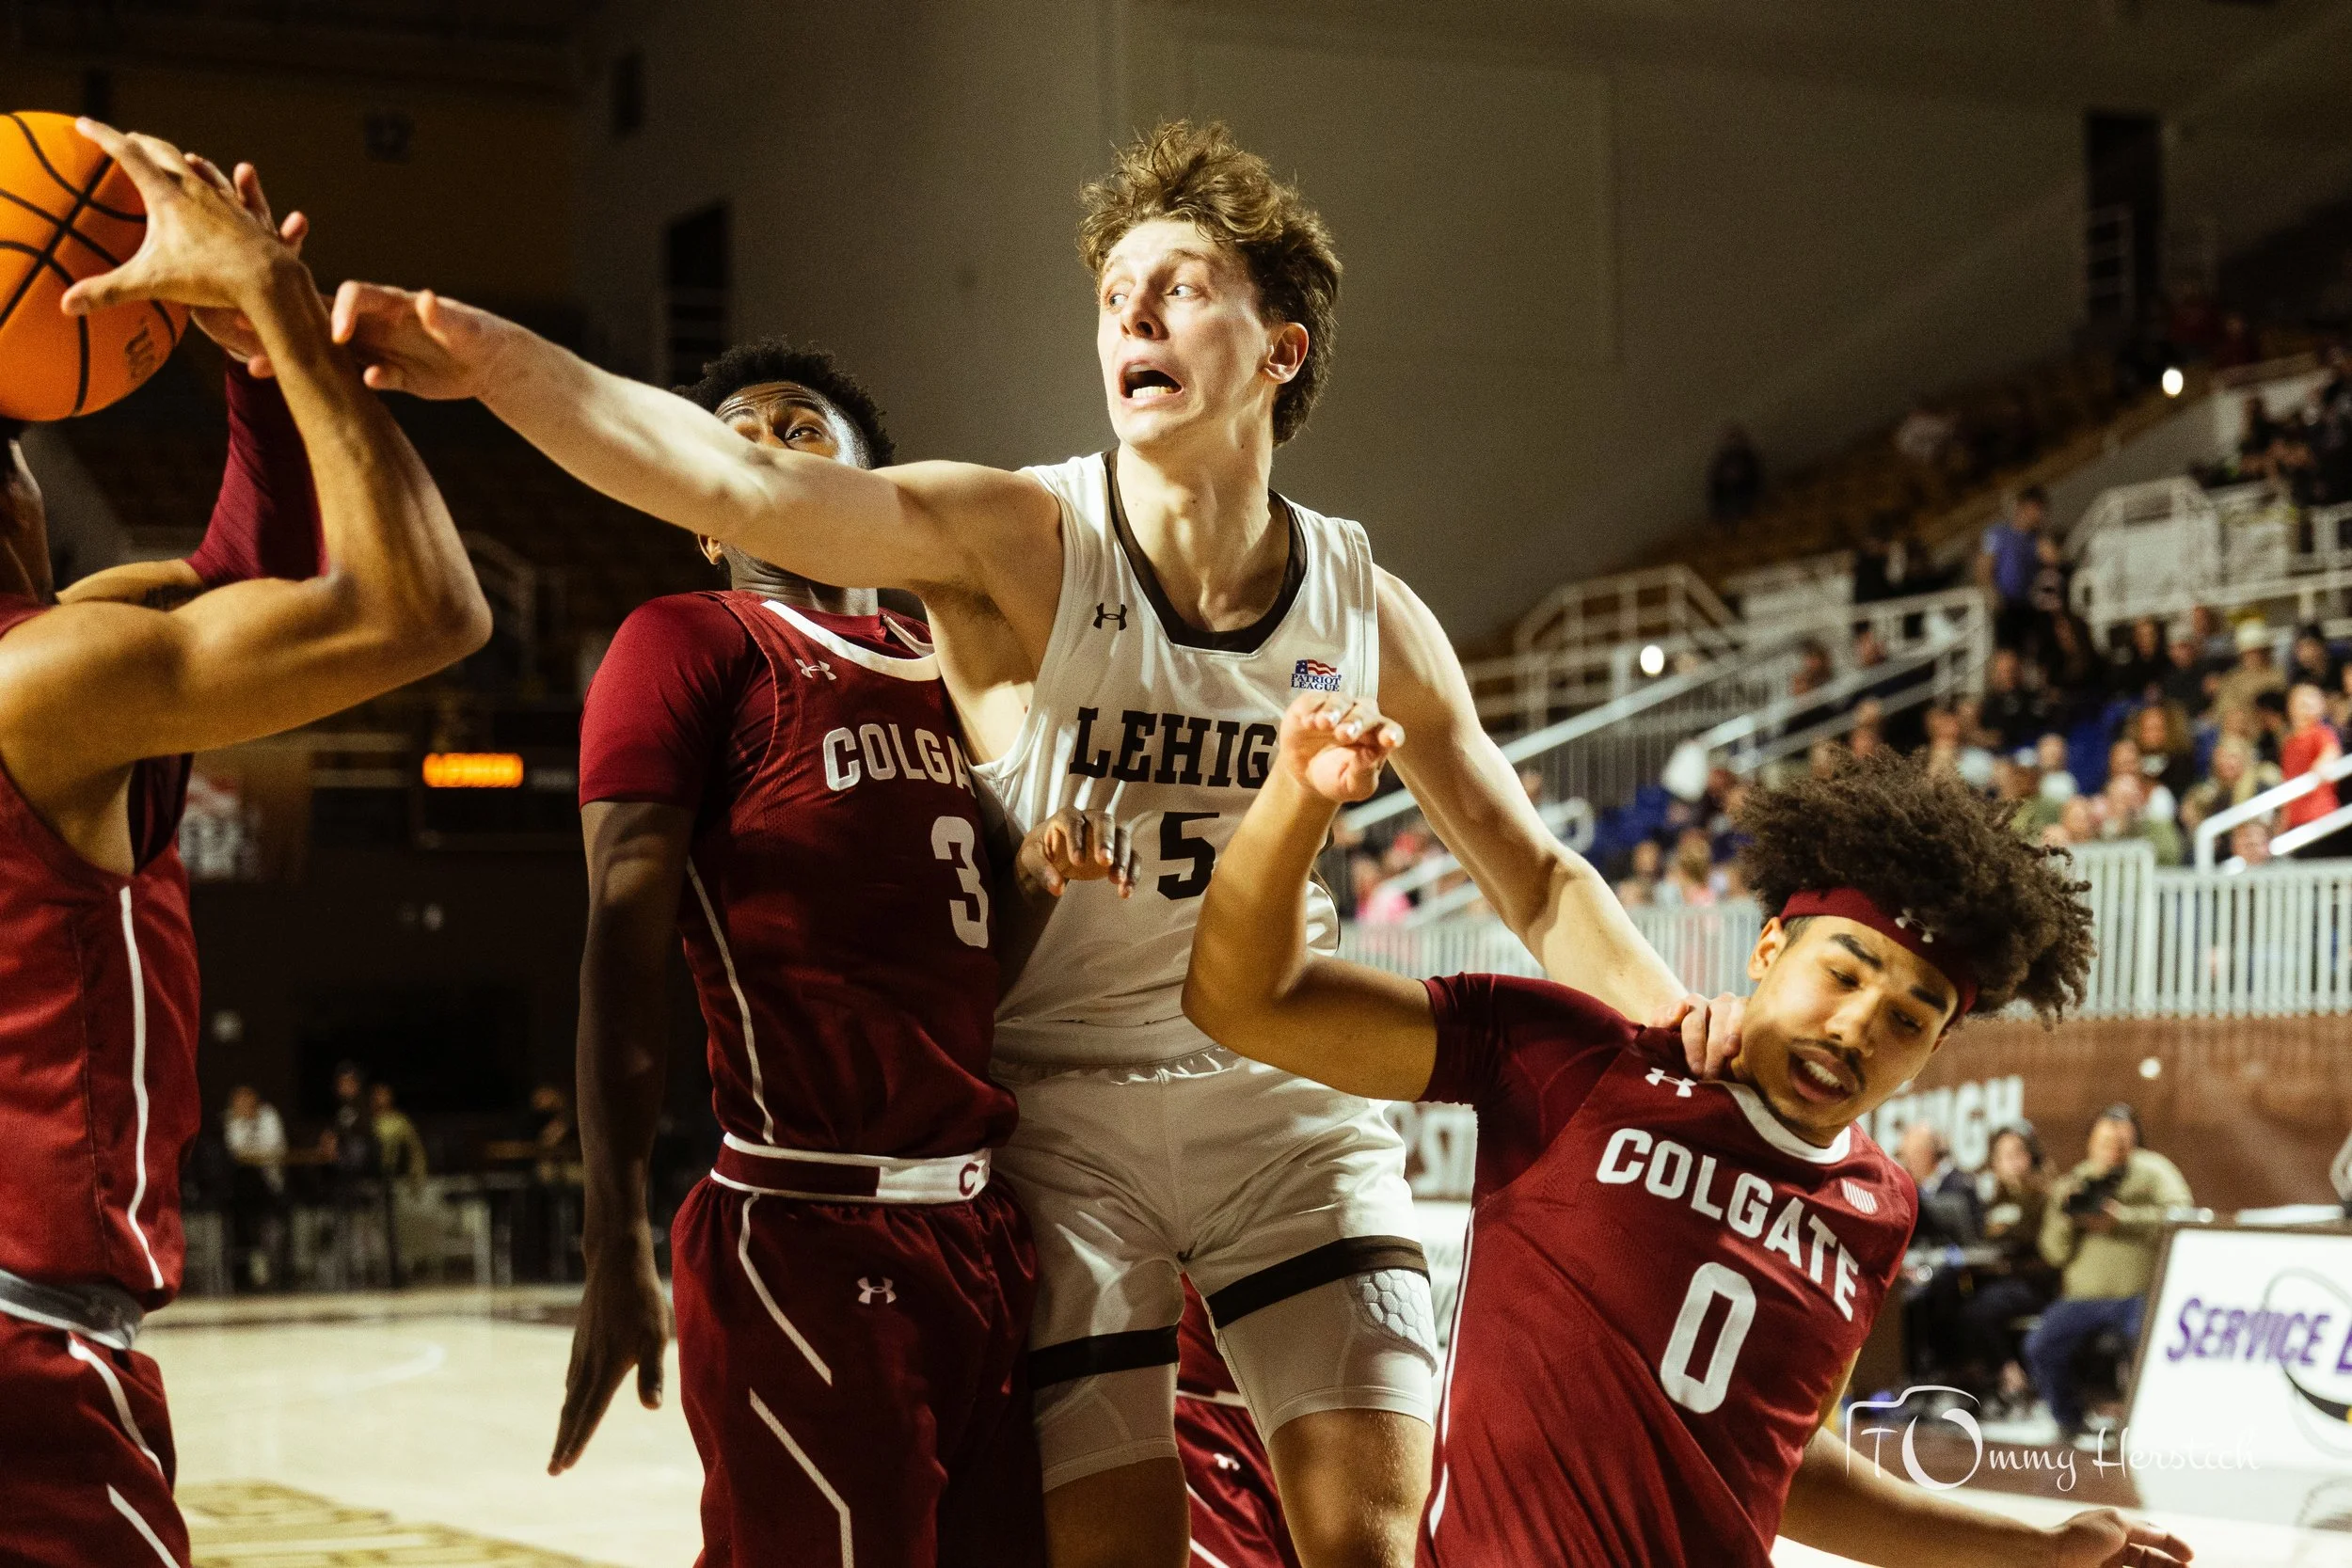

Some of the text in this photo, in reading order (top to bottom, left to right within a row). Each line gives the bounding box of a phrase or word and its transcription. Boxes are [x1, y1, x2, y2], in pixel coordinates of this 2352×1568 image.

[1291, 673, 1340, 686] PATRIOT
[1291, 681, 1340, 691] LEAGUE
[1069, 706, 1277, 789] LEHIG
[931, 816, 988, 949] 3
[1157, 811, 1220, 900] 5
[960, 1162, 979, 1196] C
[1596, 1128, 1859, 1322] COLGATE
[1660, 1261, 1756, 1414] 0
